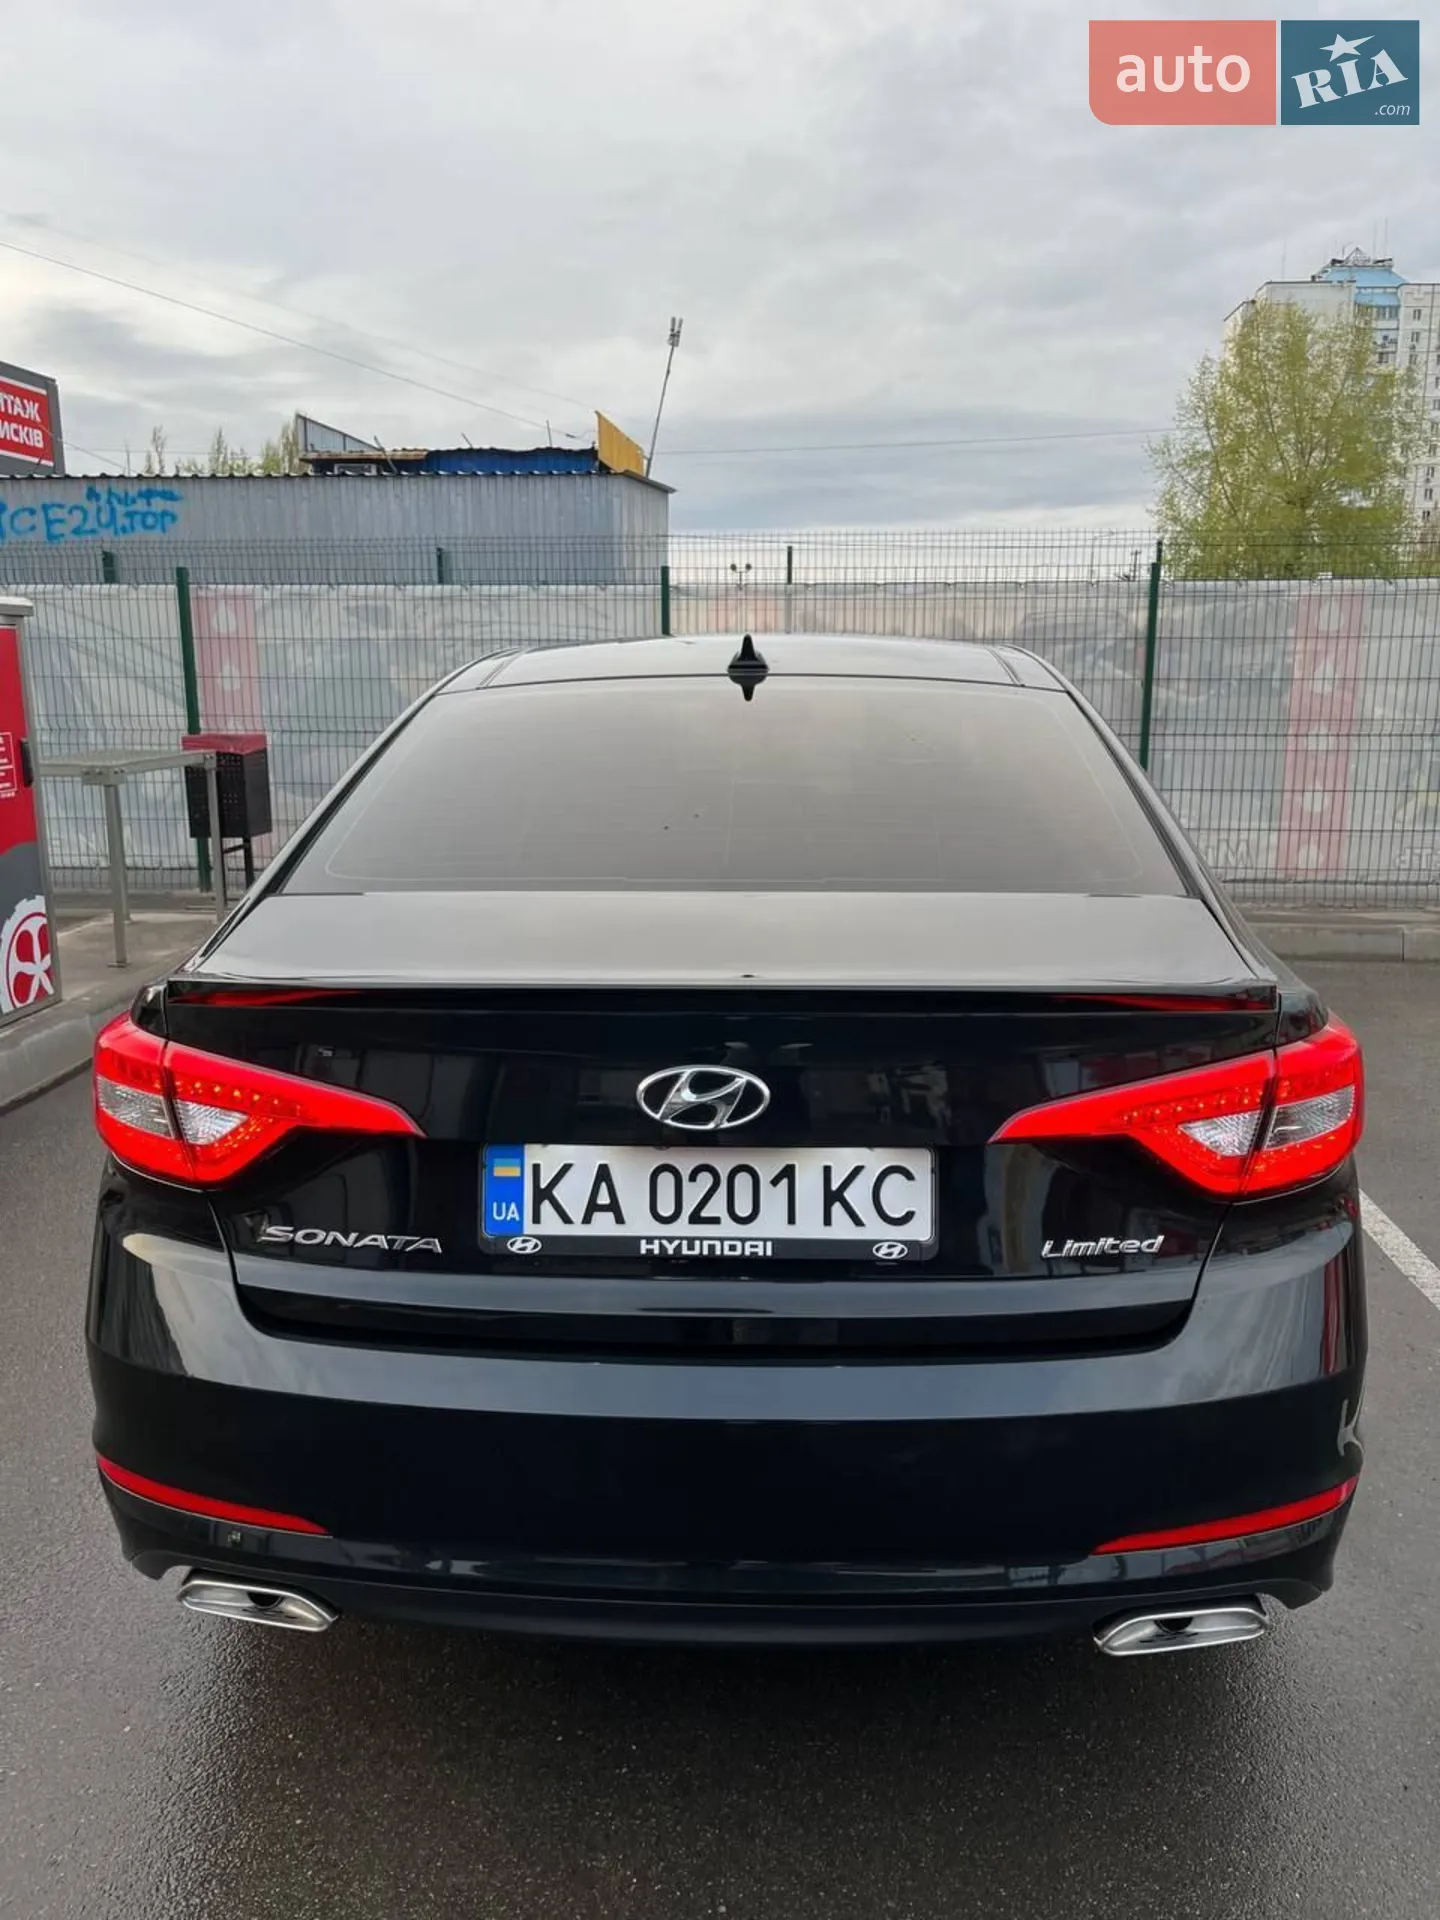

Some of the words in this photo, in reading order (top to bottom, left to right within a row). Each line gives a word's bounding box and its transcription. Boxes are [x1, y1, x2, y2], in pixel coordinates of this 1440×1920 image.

[532, 1163, 626, 1226] KA
[649, 1163, 796, 1226] 0201
[822, 1164, 917, 1227] KC
[493, 1201, 520, 1221] UA
[256, 1225, 442, 1254] SONATA
[640, 1239, 772, 1256] HYUNDAI
[1041, 1235, 1165, 1258] Limited
